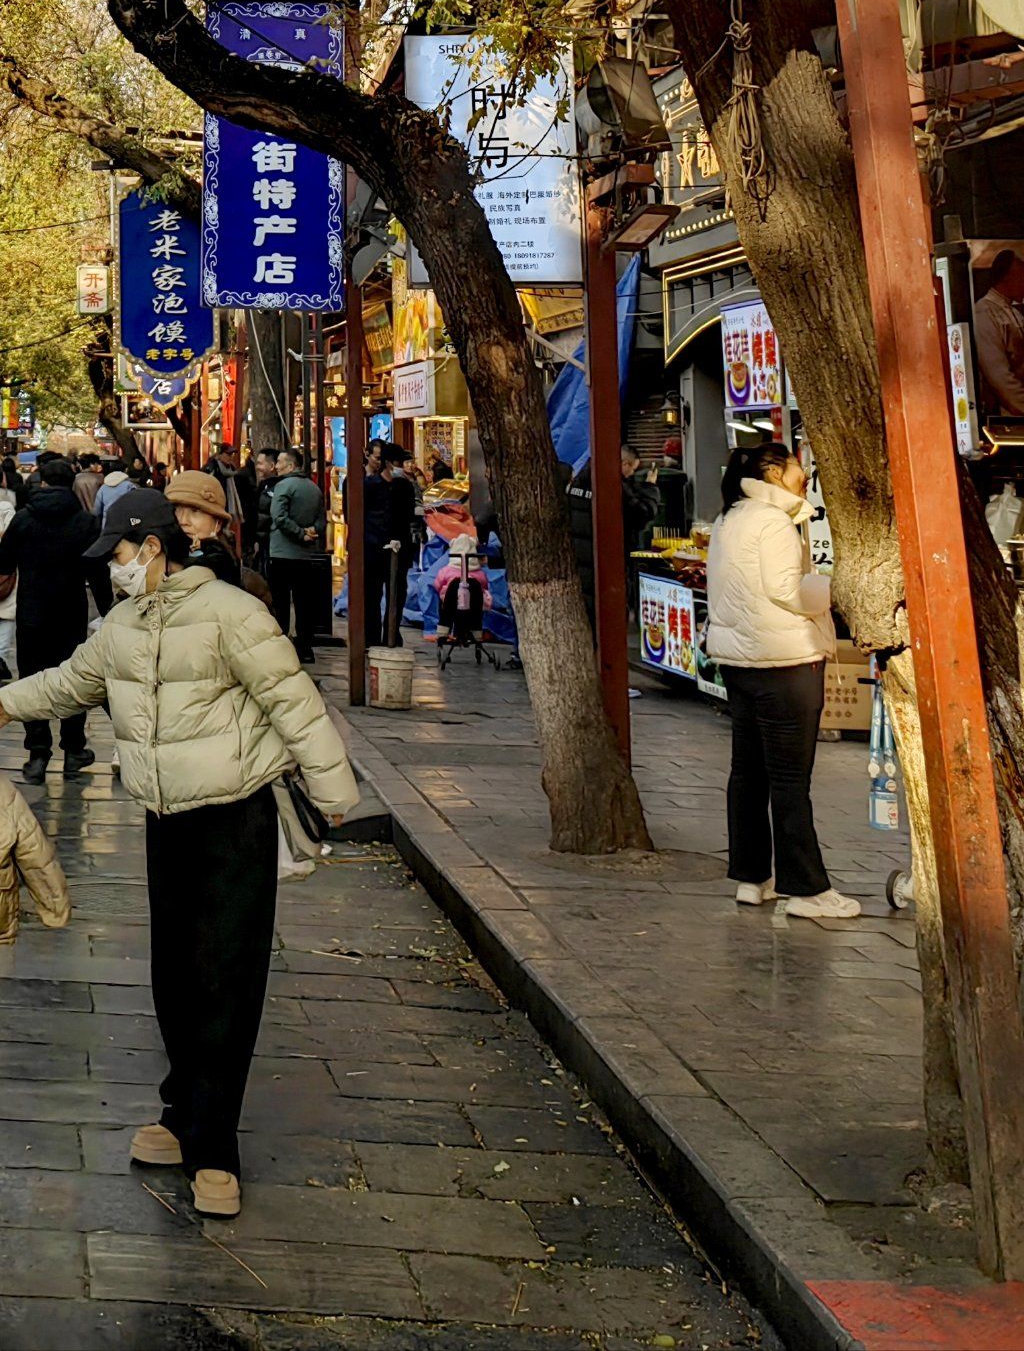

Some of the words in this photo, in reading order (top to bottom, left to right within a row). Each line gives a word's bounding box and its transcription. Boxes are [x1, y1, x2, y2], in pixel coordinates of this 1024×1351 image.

[148, 209, 188, 344] 老米家泡馍
[251, 133, 297, 285] 街特产店
[145, 348, 195, 361] 老字号
